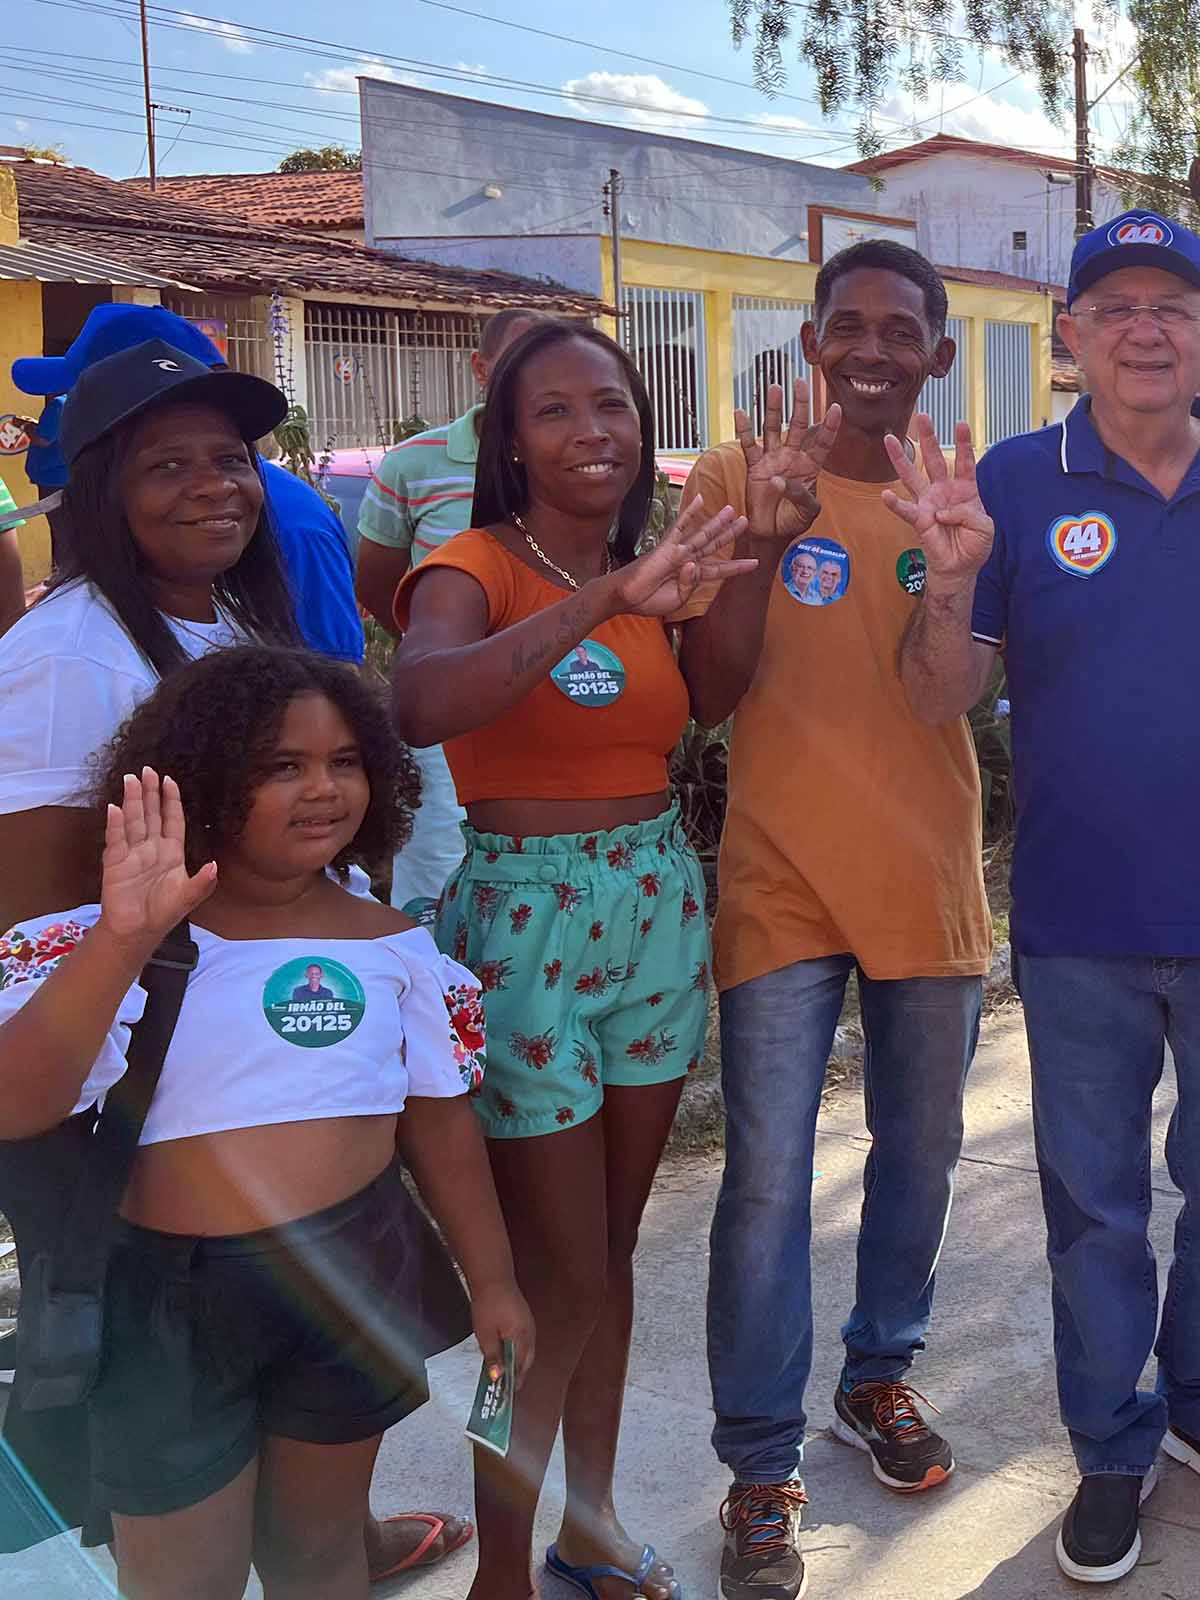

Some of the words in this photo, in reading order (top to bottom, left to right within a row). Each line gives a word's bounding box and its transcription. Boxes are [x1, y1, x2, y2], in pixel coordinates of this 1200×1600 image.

[1120, 226, 1161, 243] 44
[1063, 523, 1102, 555] 44
[567, 681, 620, 696] 20125
[287, 1000, 324, 1012] IRMÃO
[325, 1002, 346, 1011] DEL
[280, 1014, 352, 1033] 20125
